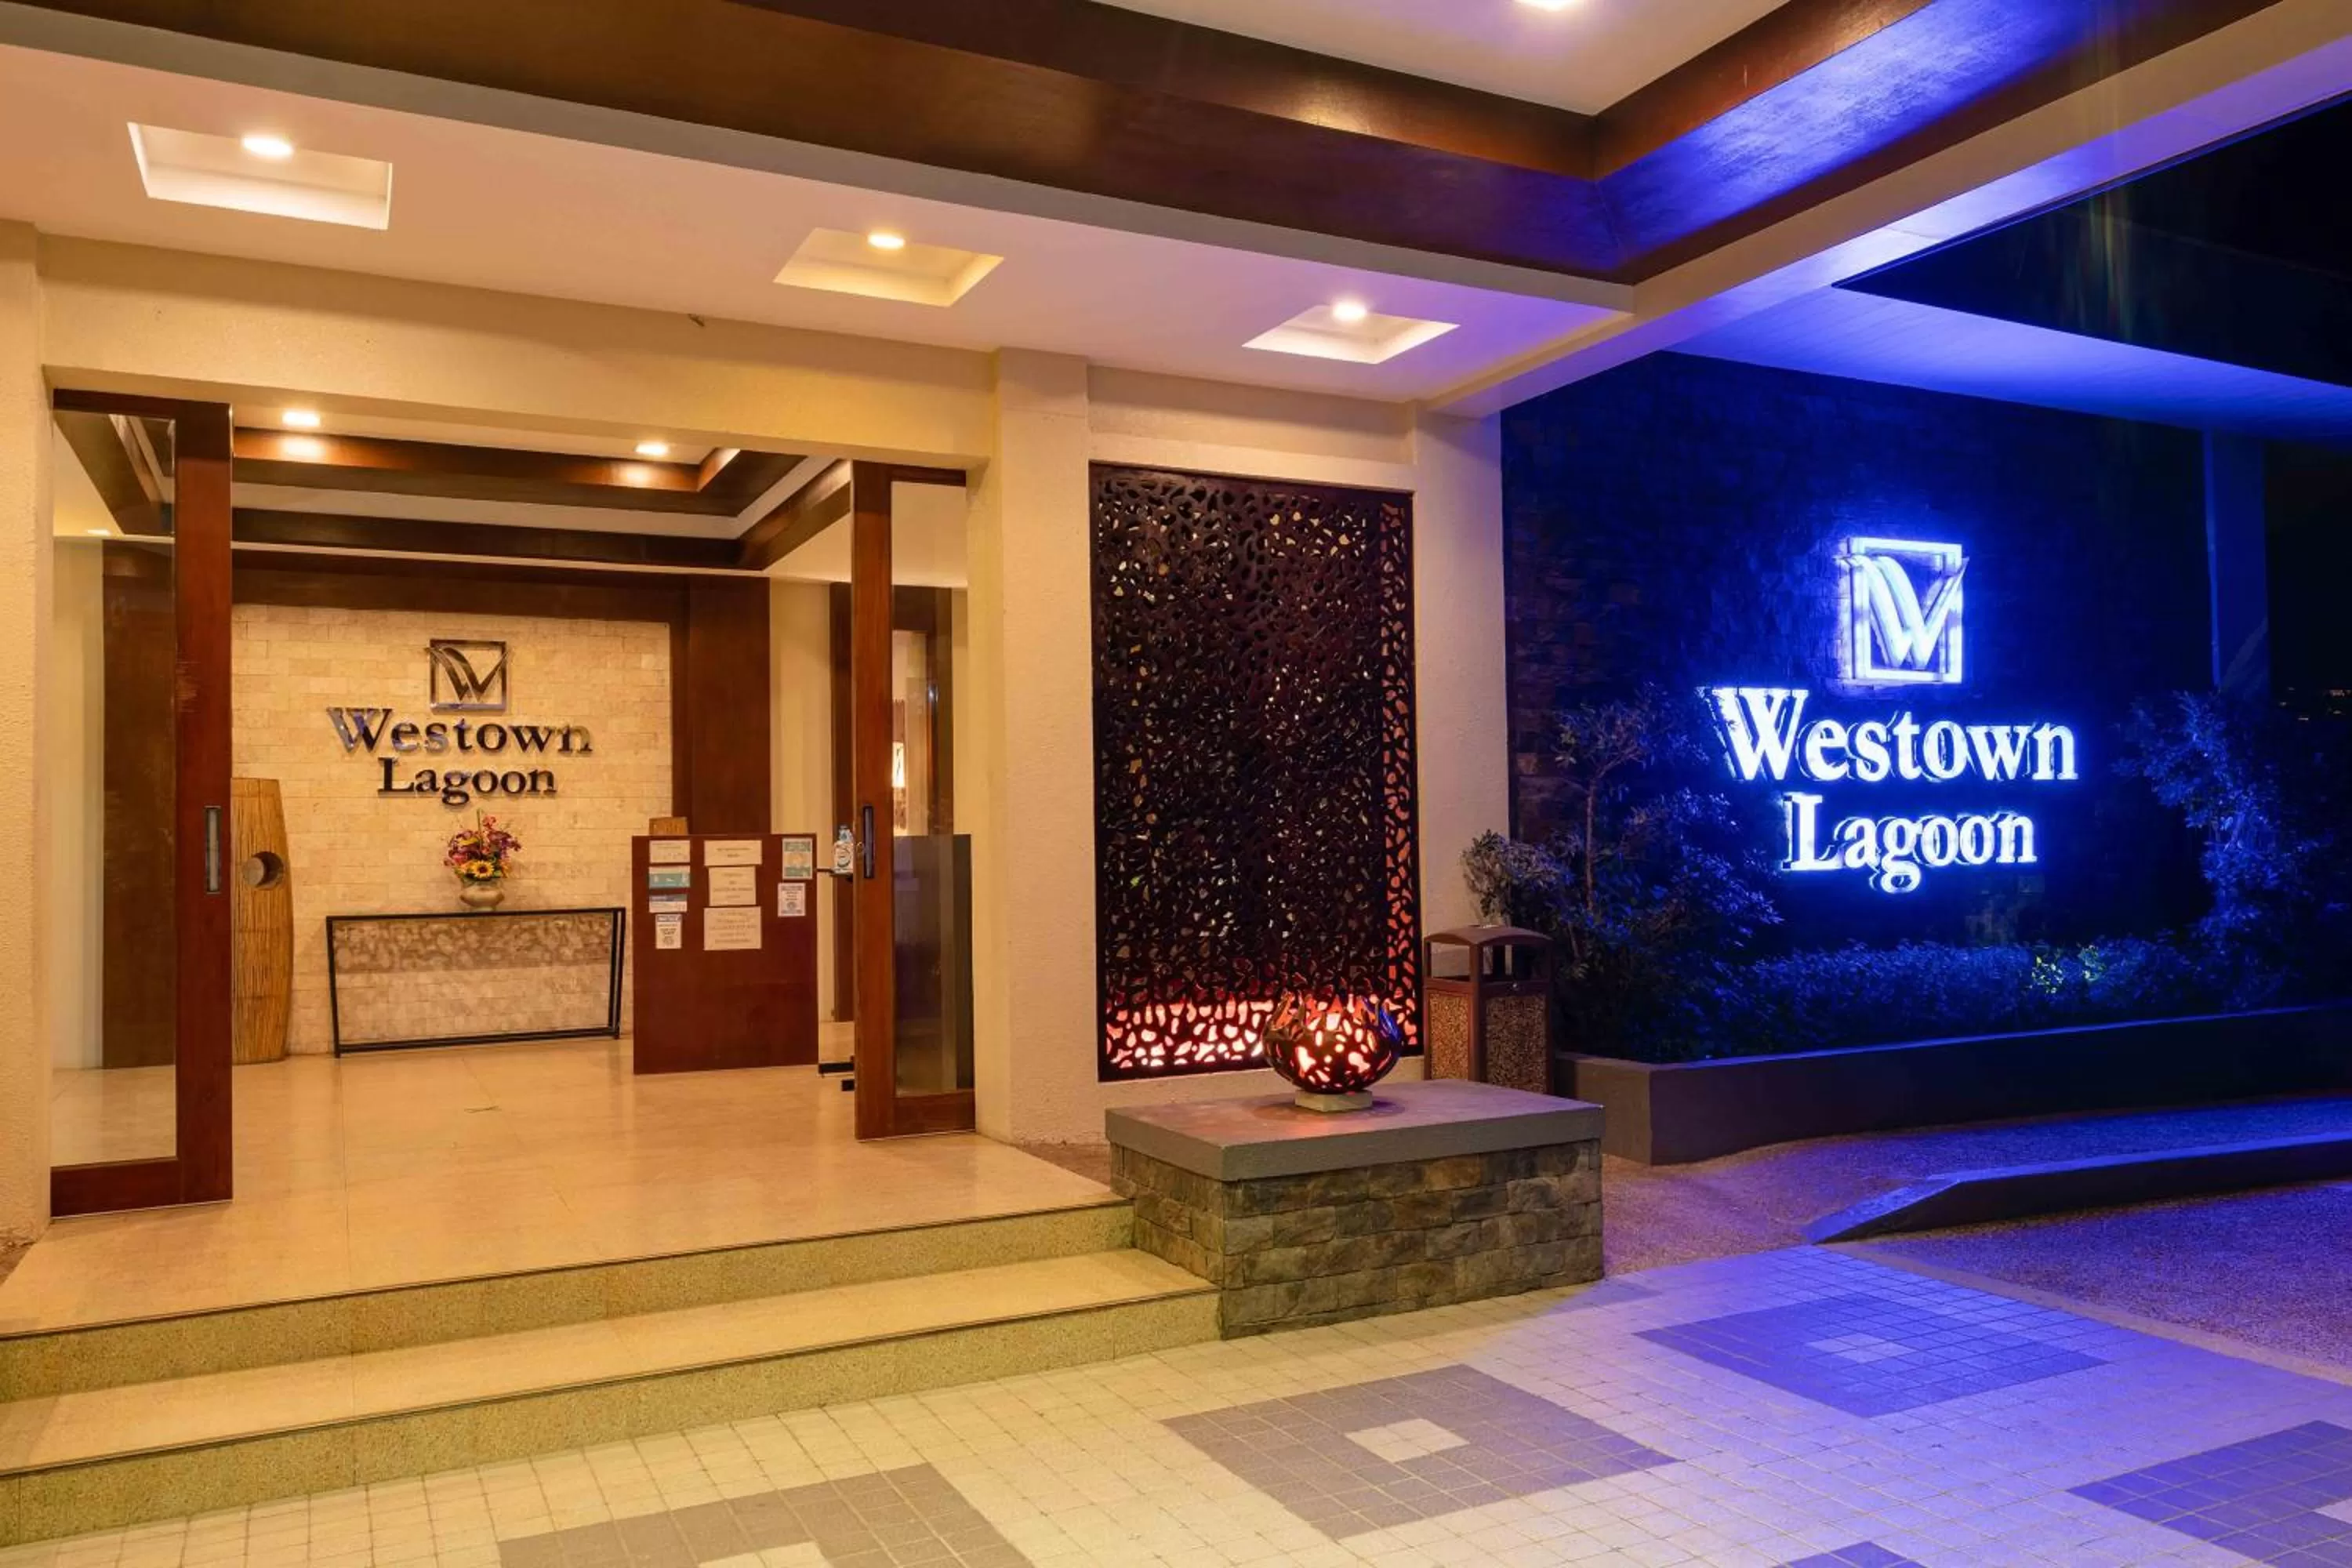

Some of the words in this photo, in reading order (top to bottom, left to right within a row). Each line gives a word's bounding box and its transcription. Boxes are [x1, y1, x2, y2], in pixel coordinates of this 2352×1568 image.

[325, 706, 593, 753] Westown
[1703, 686, 2078, 782] Westown
[377, 757, 557, 807] Lagoon
[1782, 792, 2038, 894] Lagoon
